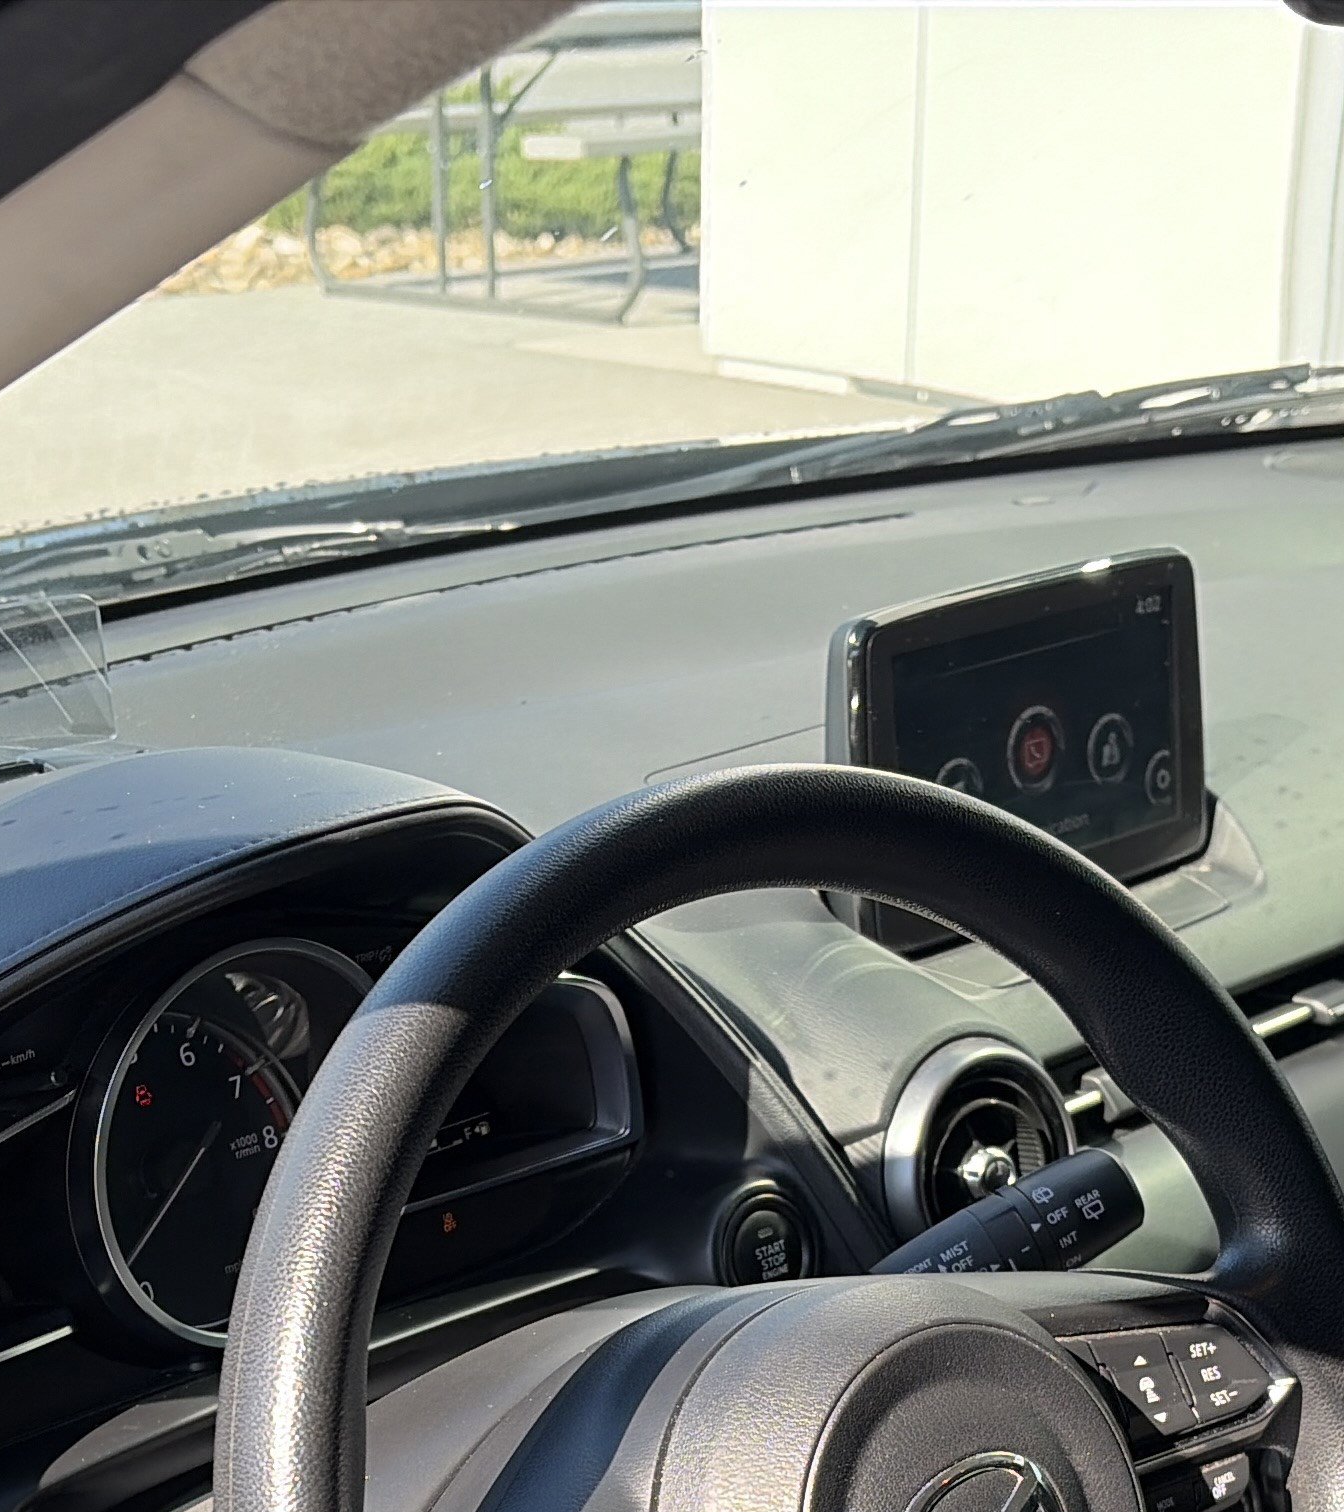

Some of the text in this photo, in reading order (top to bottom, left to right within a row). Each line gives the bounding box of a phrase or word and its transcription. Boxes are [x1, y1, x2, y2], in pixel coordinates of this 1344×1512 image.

[179, 1042, 196, 1067] 6
[228, 1075, 241, 1099] 7
[262, 1125, 278, 1149] 8
[1074, 1189, 1101, 1208] REAR
[1046, 1206, 1069, 1226] OFF
[1059, 1230, 1078, 1249] INT
[755, 1239, 785, 1260] START
[939, 1240, 969, 1263] MIST
[761, 1252, 786, 1270] STOP
[951, 1255, 973, 1273] OFF
[1066, 1254, 1082, 1268] ON
[1189, 1341, 1217, 1359] SET+
[1200, 1365, 1222, 1382] RES
[1209, 1389, 1238, 1407] SET-
